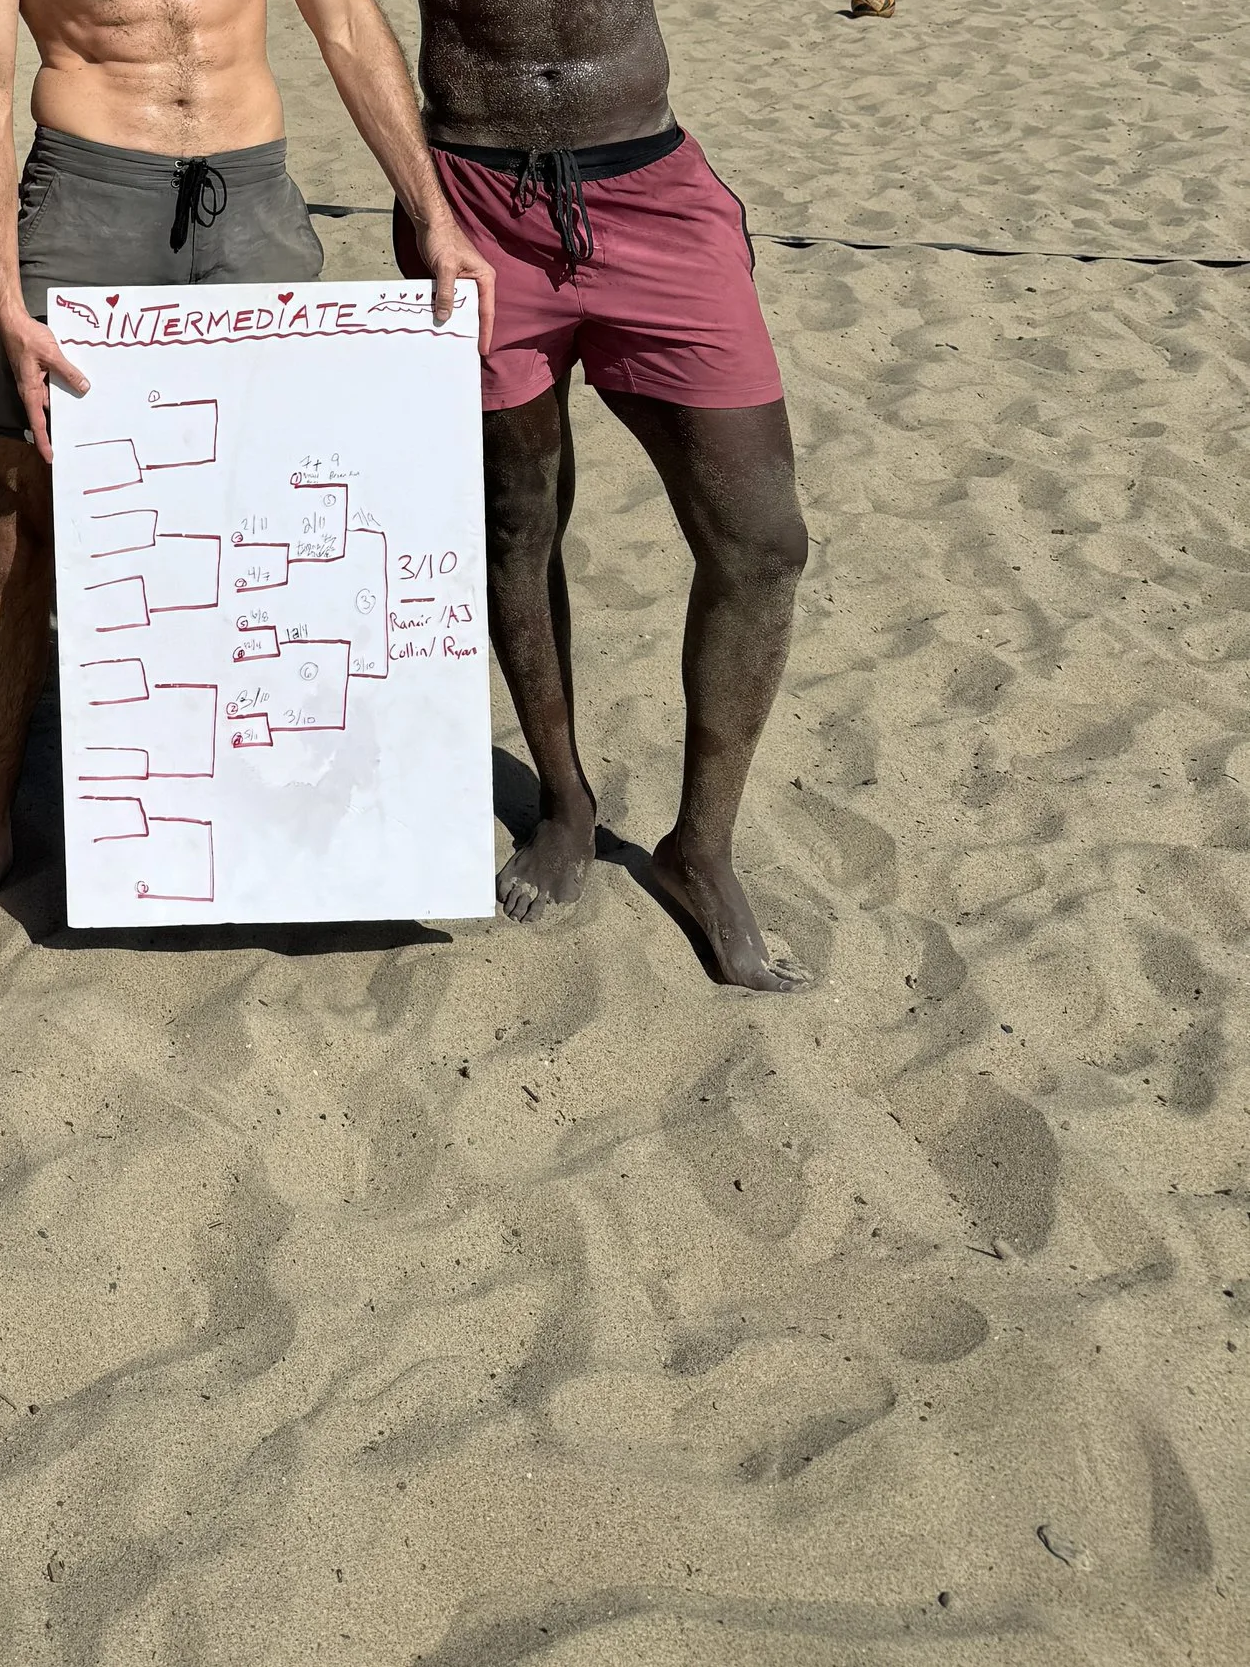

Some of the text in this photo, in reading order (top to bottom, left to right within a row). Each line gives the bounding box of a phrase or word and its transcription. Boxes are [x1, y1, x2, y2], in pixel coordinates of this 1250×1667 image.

[398, 551, 458, 580] 3/10
[443, 636, 478, 660] Ryan
[353, 657, 375, 673] 3/10
[284, 709, 316, 726] 3/10
